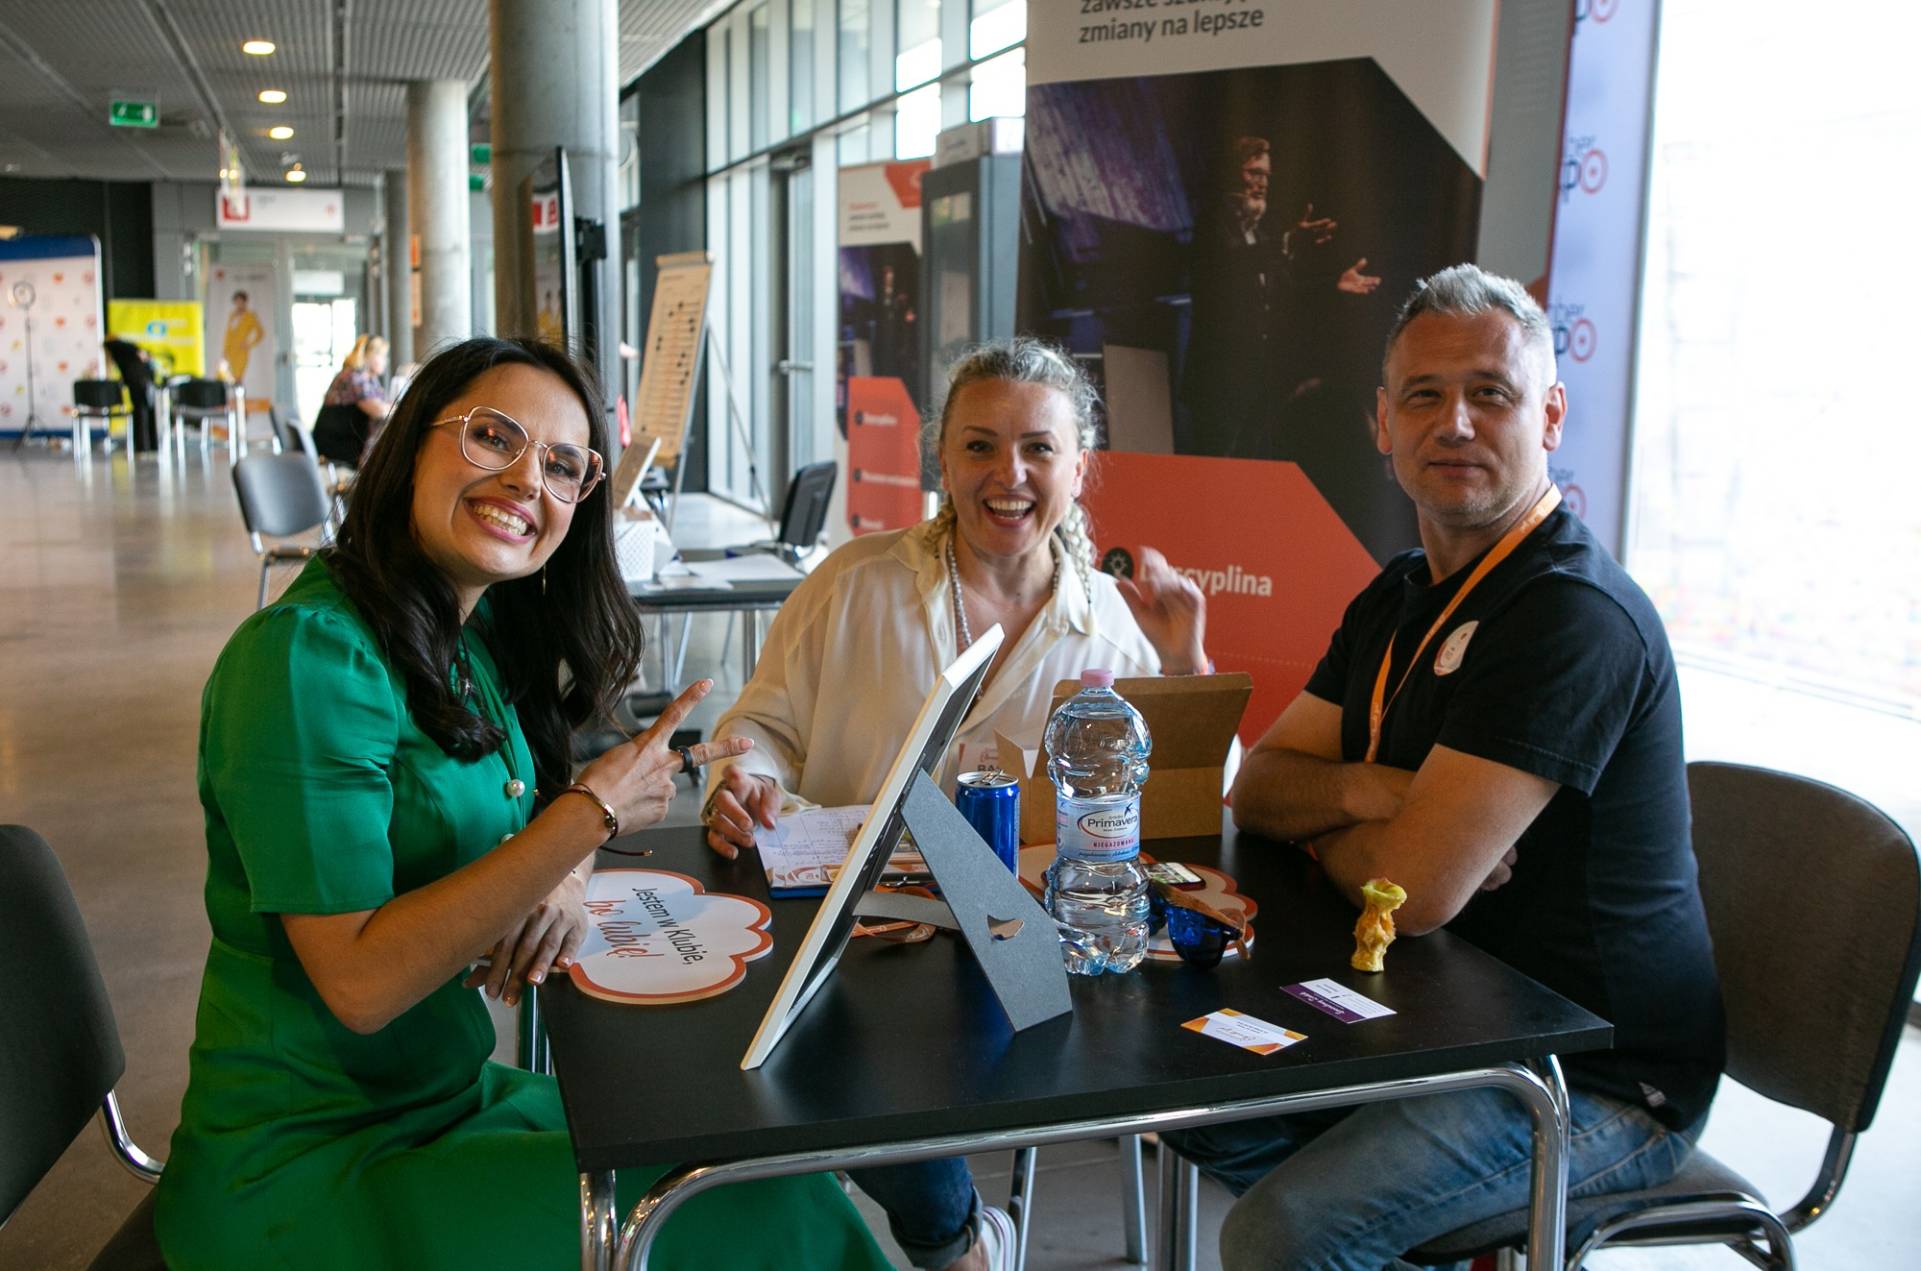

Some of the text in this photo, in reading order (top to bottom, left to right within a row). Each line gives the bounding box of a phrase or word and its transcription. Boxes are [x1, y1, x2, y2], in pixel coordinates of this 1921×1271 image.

[1078, 9, 1264, 43] zmiany na lepsze
[1087, 815, 1138, 828] Primavera
[583, 899, 627, 916] bo
[632, 887, 708, 965] Jestem w Klubie,
